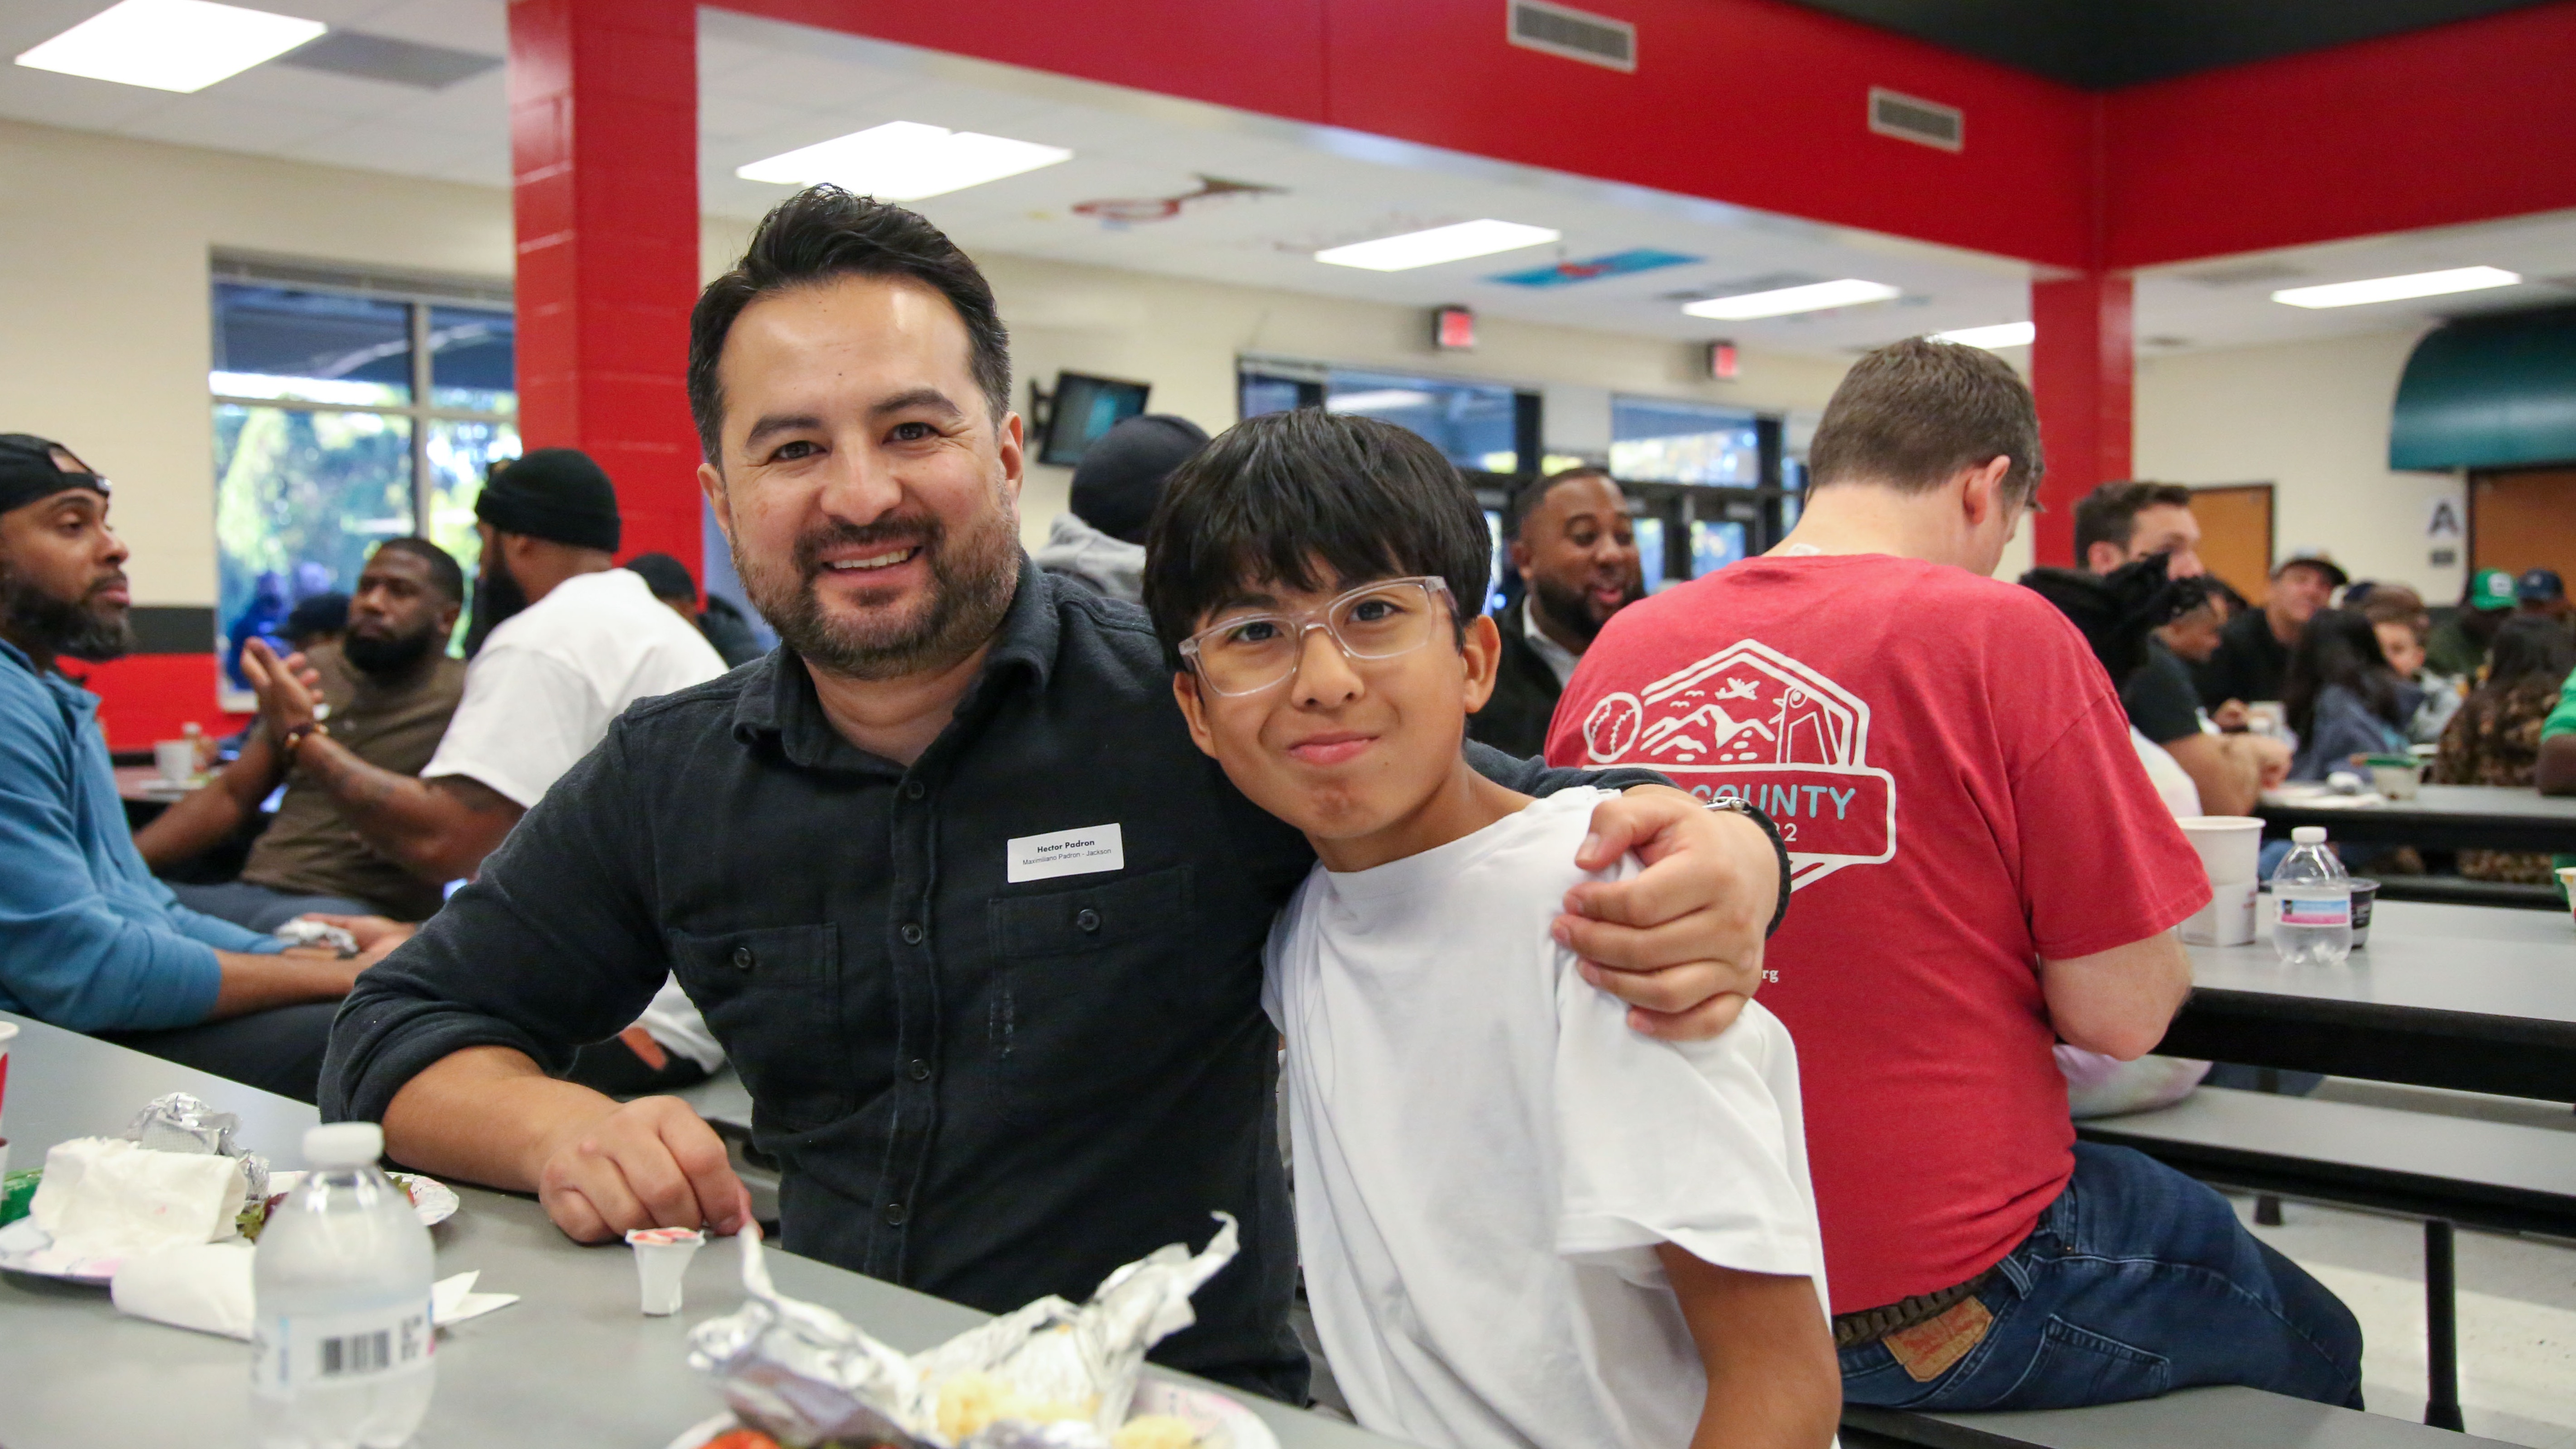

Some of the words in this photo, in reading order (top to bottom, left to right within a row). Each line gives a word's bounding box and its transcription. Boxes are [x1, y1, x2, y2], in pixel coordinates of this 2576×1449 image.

[2429, 501, 2458, 536] A
[1037, 845, 1063, 853] Hector
[1065, 840, 1095, 848] Padron
[1023, 856, 1057, 865] Maximiliano
[1086, 848, 1111, 856] Jackson
